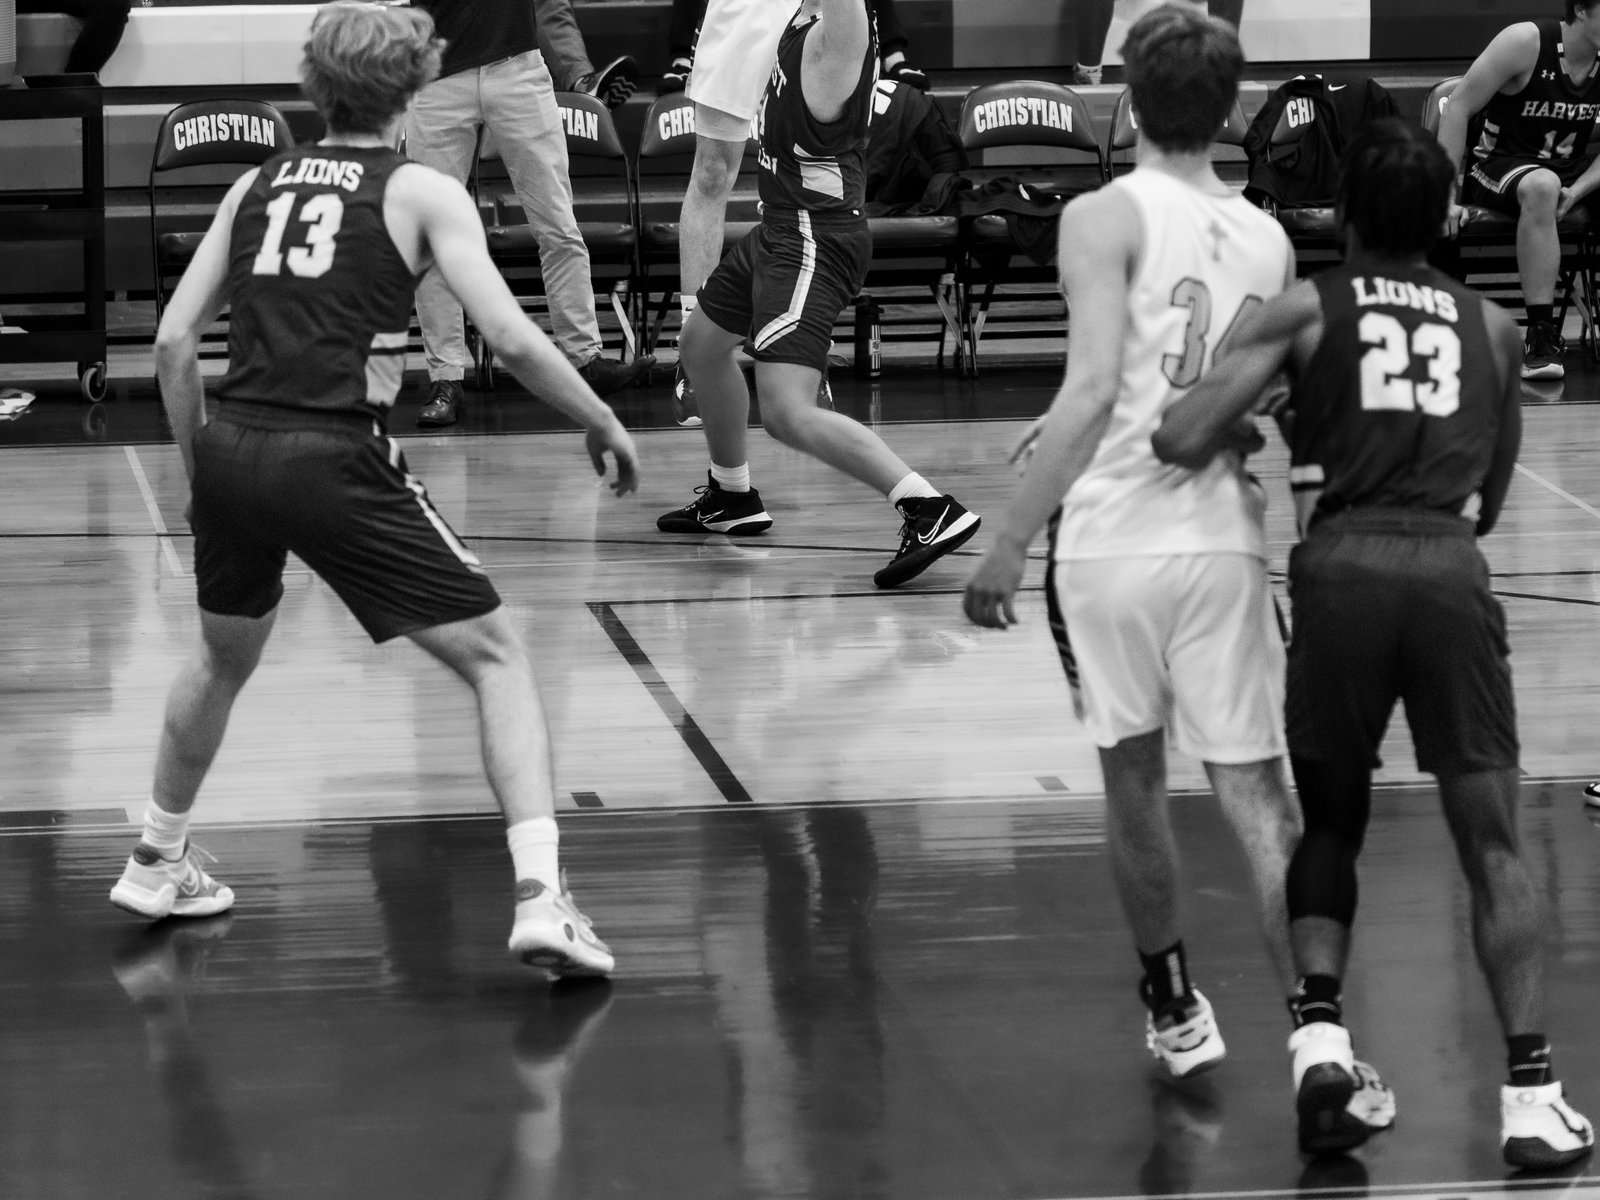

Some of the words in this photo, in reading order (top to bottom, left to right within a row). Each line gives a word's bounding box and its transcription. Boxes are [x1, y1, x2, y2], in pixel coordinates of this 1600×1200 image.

[174, 113, 275, 151] CHRISTIAN
[974, 97, 1073, 133] CHRISTIAN
[1537, 130, 1577, 159] 14
[270, 157, 364, 192] LIONS
[252, 191, 344, 279] 13
[1351, 276, 1458, 322] LIONS
[1358, 311, 1461, 417] 23
